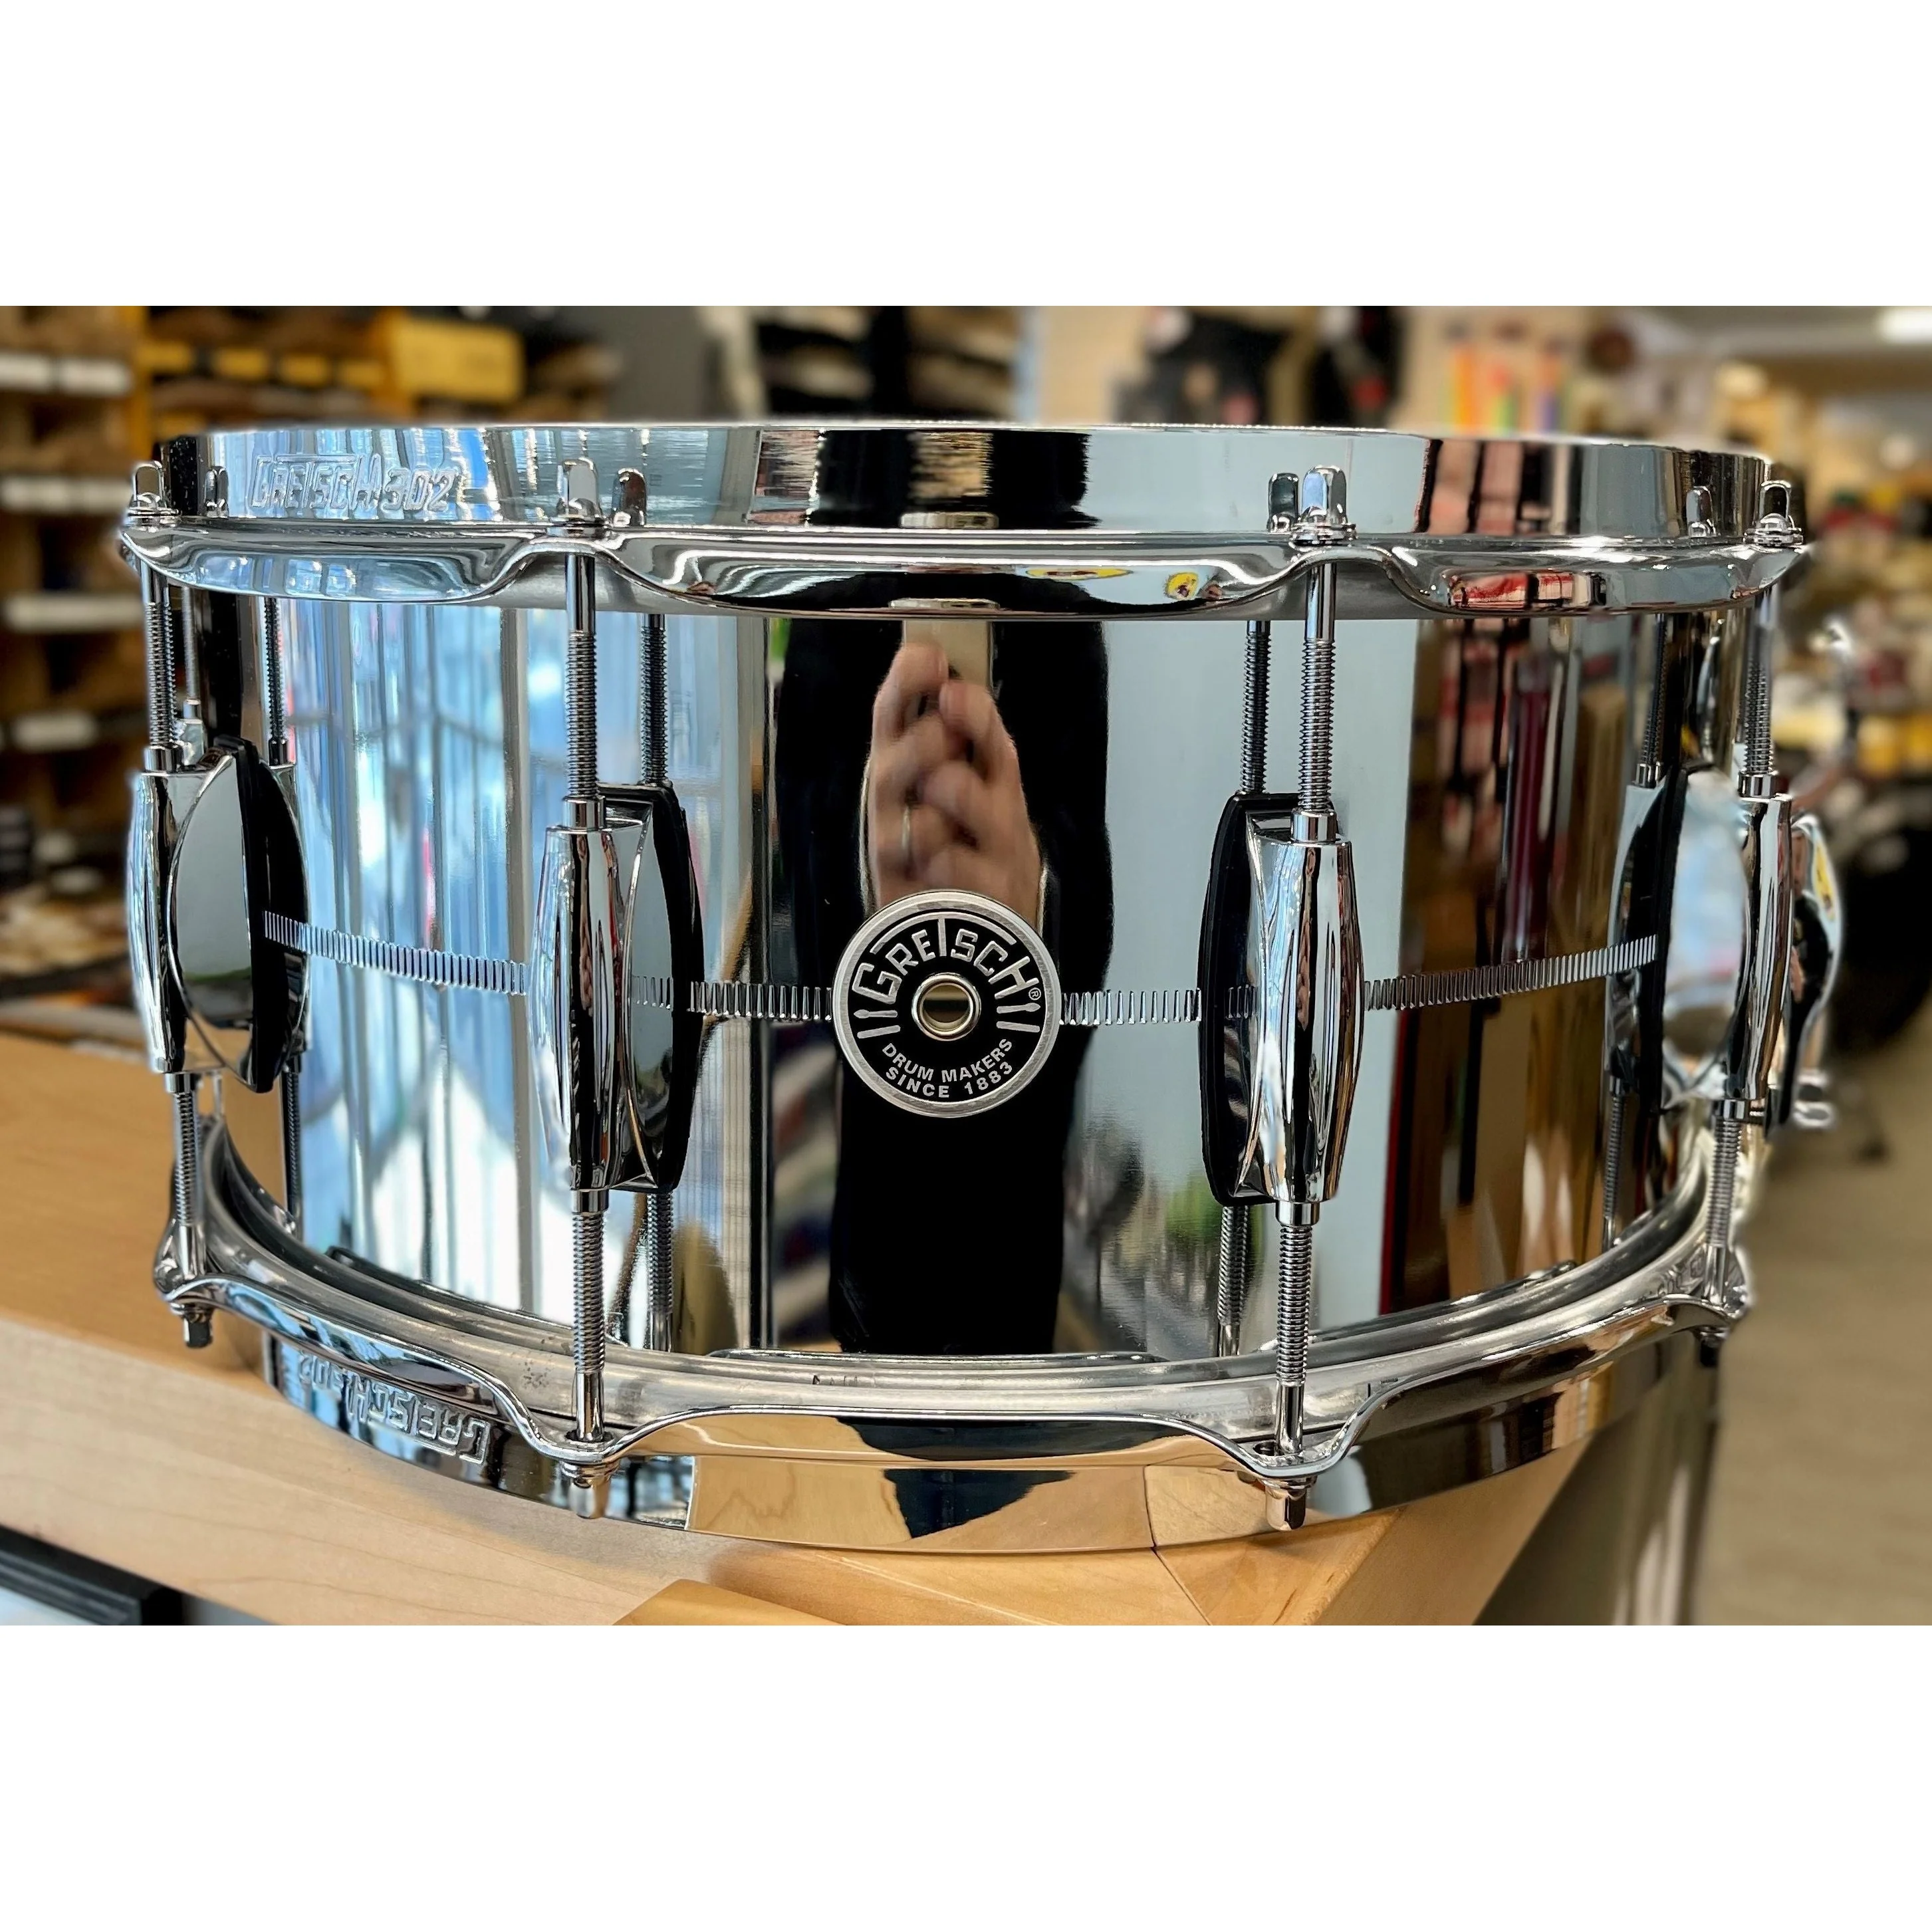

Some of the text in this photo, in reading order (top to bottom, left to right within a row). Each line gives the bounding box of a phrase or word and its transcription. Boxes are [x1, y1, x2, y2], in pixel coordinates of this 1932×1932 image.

[250, 453, 459, 511] GRETSCH 302
[882, 1038, 1013, 1082] DRUM MAKERS
[886, 1062, 1013, 1098] SINCE 1883
[345, 1371, 491, 1464] GRETSCH
